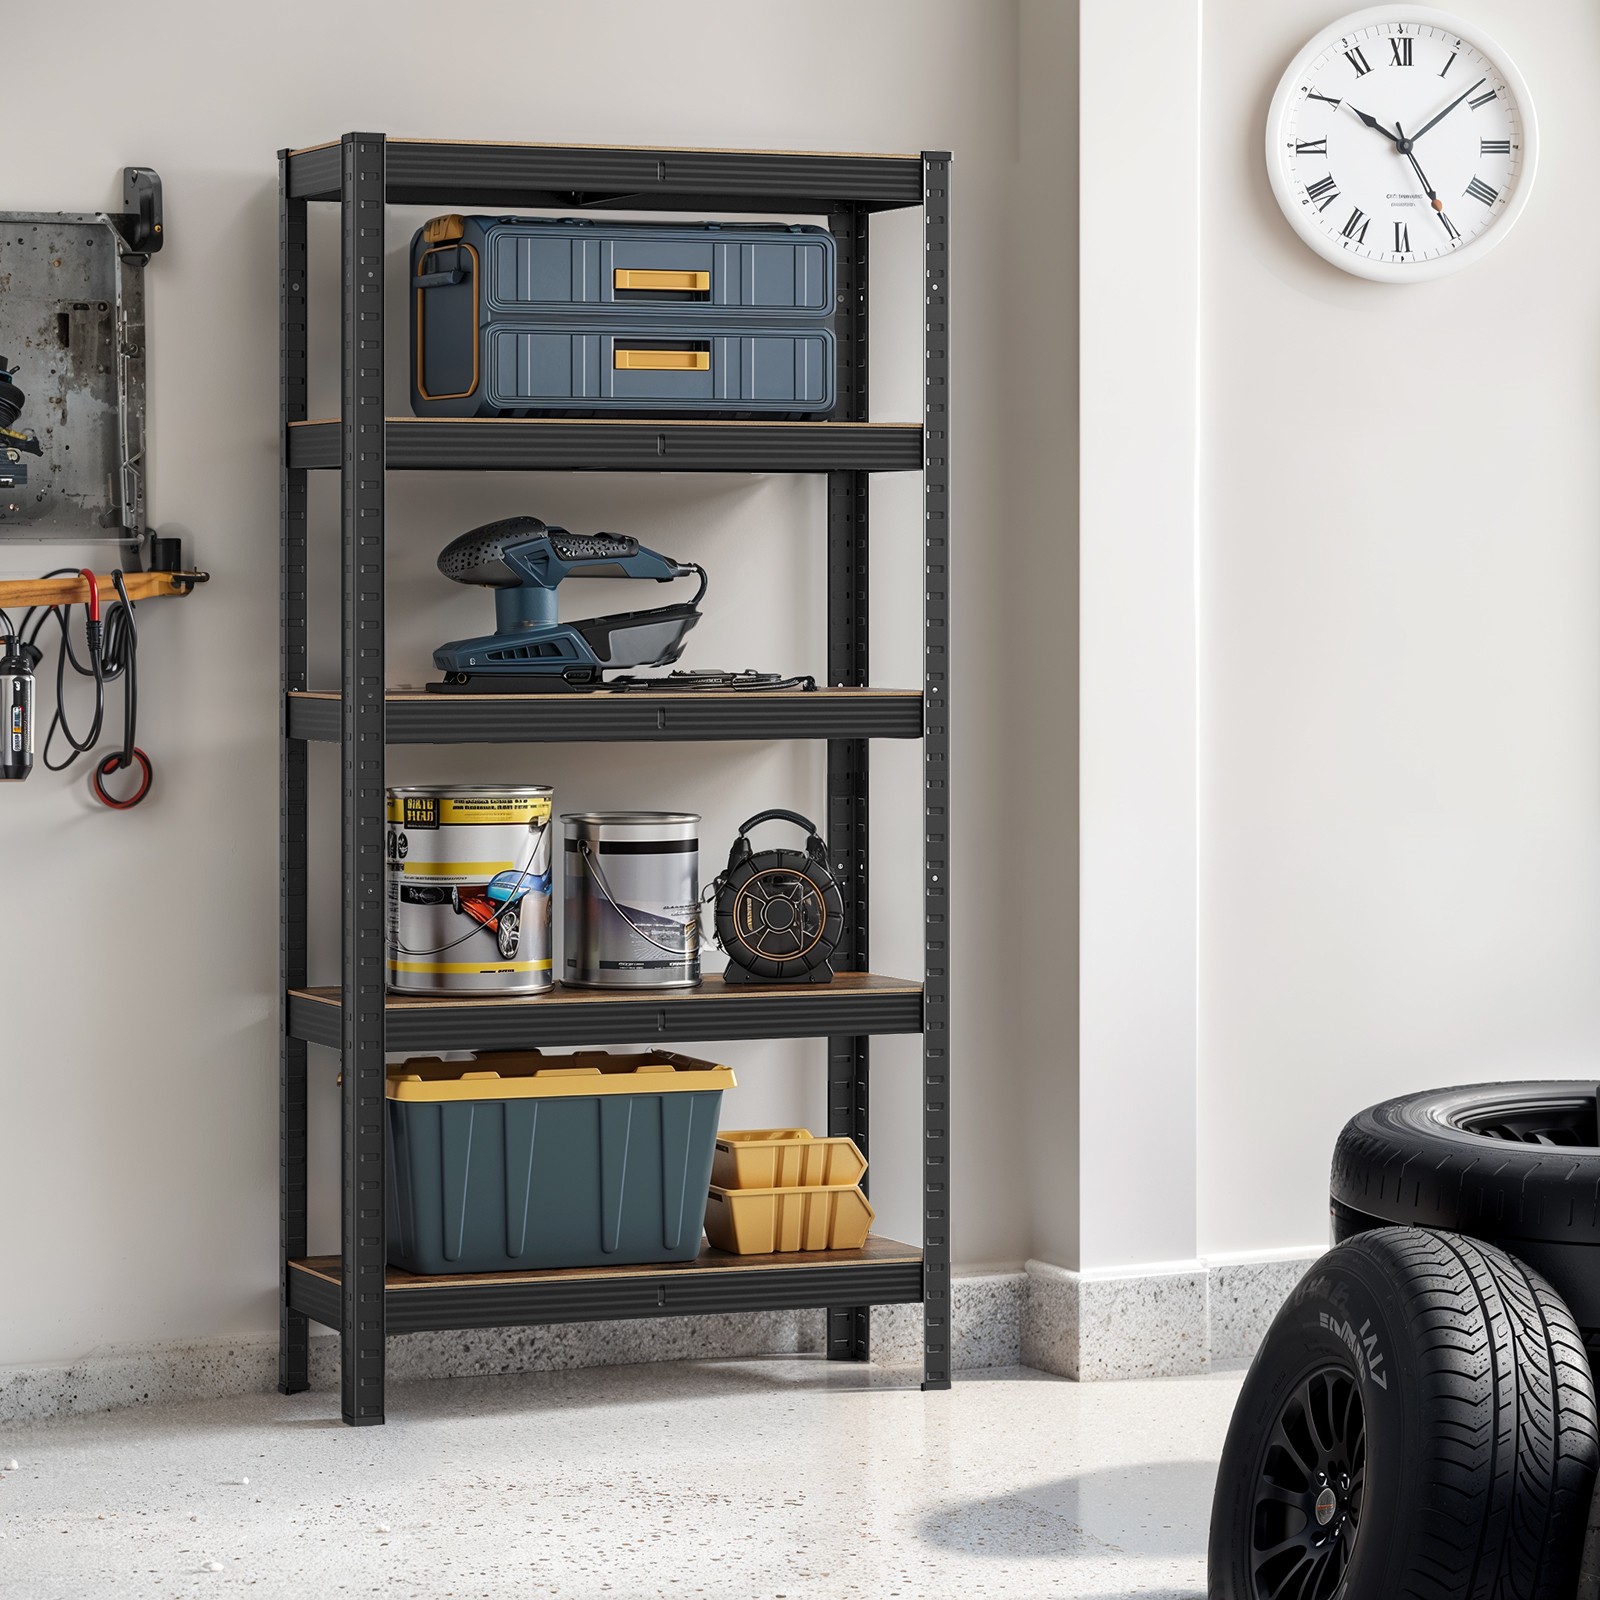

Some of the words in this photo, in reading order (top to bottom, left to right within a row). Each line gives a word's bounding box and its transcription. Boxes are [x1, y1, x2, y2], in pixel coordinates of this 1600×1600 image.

[1388, 38, 1415, 67] XII
[1480, 136, 1511, 158] III
[1392, 221, 1413, 253] VI
